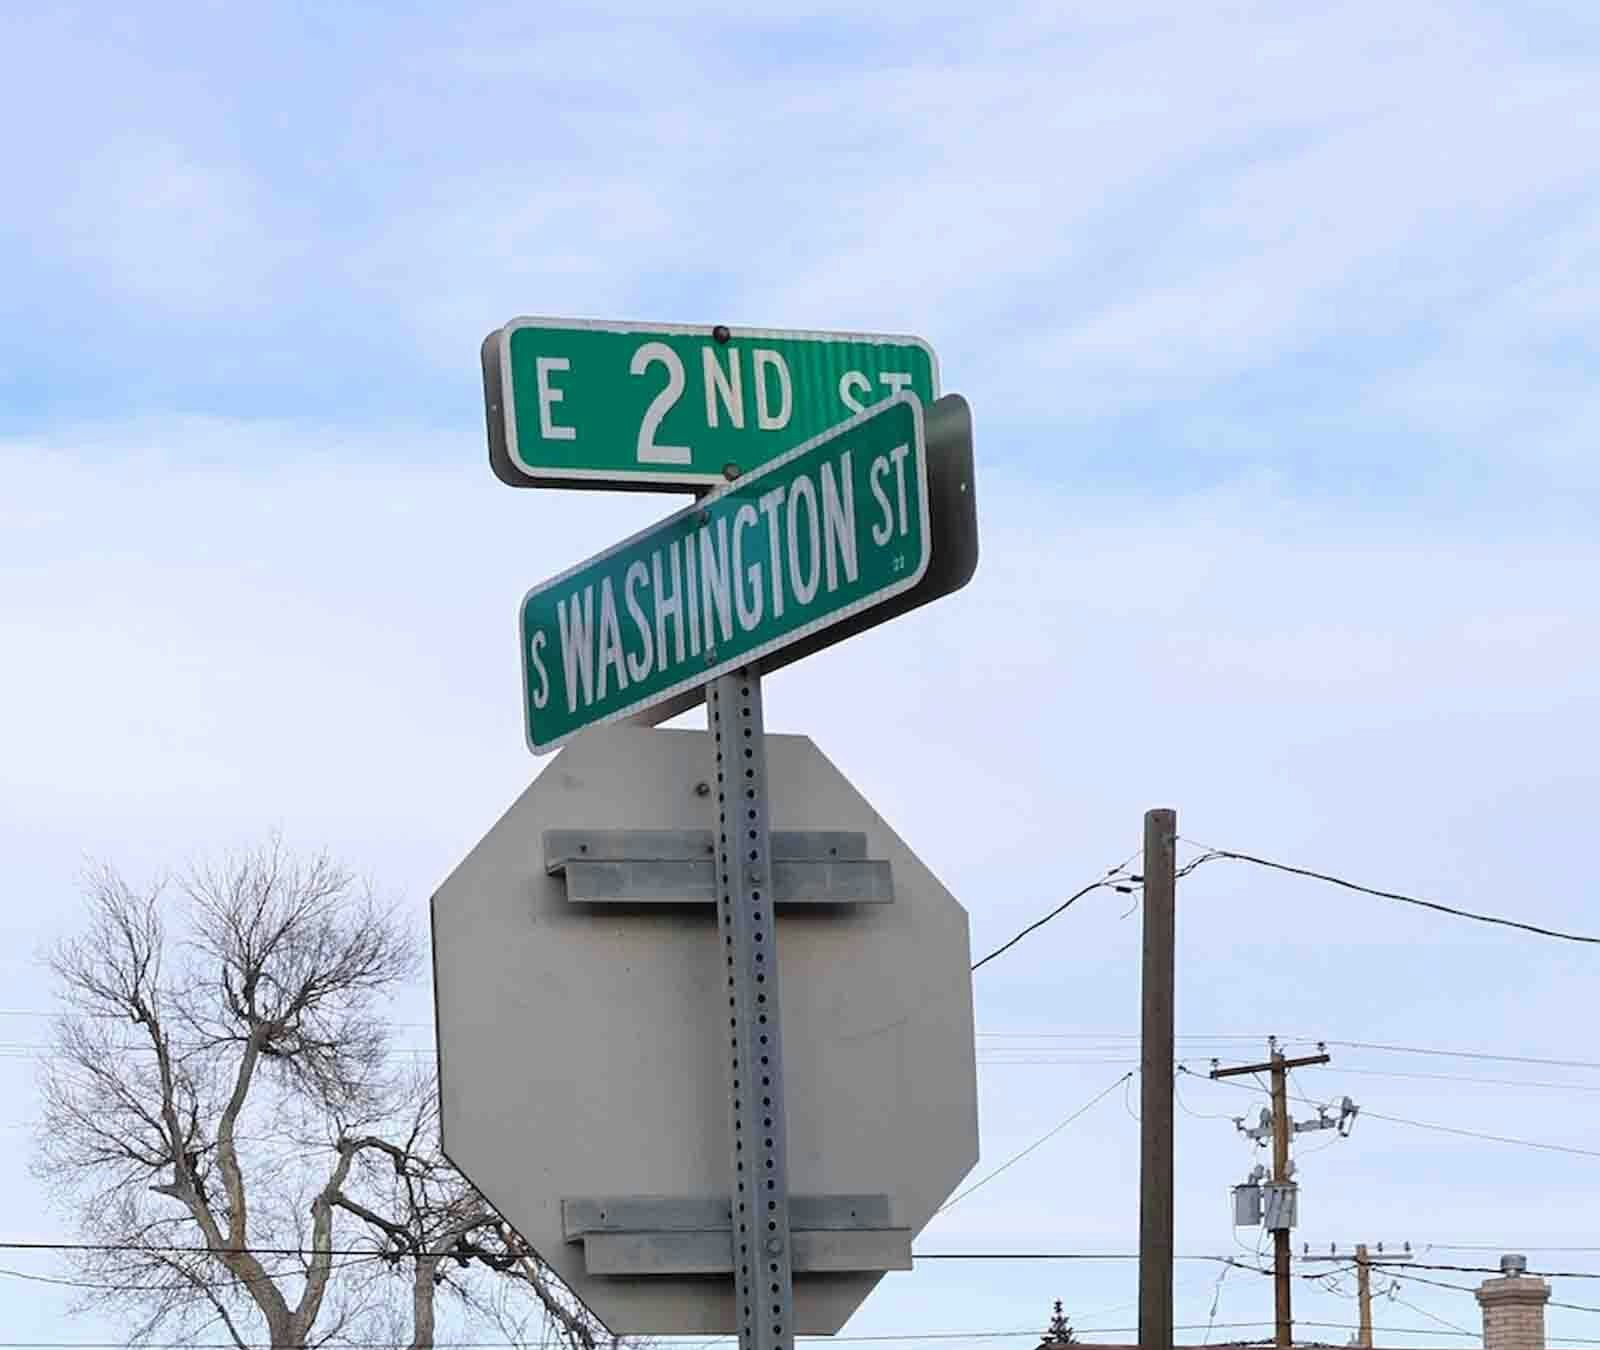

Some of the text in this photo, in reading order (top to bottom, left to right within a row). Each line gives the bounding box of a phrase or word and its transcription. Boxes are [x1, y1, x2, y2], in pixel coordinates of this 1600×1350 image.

[536, 357, 576, 440] E
[629, 342, 793, 465] 2ND
[531, 443, 909, 714] S WASHINGTON ST
